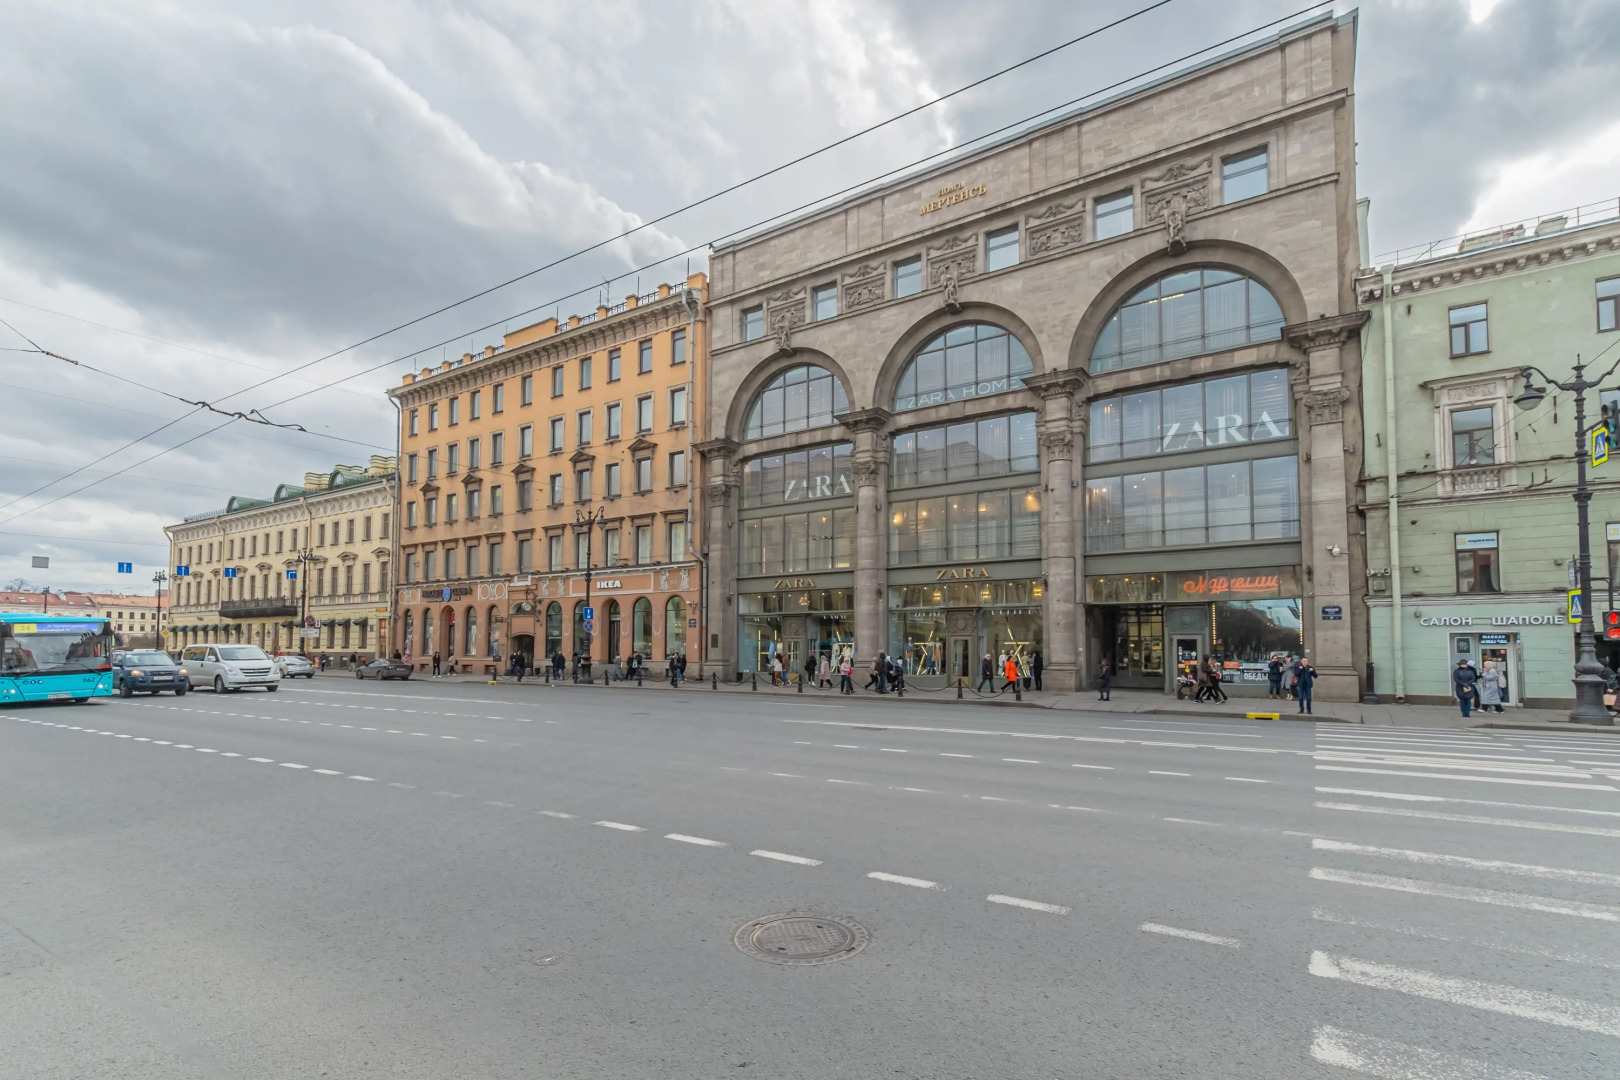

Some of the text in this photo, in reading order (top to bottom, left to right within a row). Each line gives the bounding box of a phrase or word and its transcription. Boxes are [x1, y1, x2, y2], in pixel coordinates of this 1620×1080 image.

[920, 185, 987, 216] МЕРТЕНСЪ
[907, 376, 1021, 408] ZARA HOME
[1156, 411, 1287, 452] ZARA
[785, 473, 853, 501] ZARA
[936, 567, 990, 580] ZARA
[596, 579, 622, 589] IKEA
[774, 578, 816, 589] ZARA
[1420, 615, 1565, 626] САЛОН ШАПОЛЕ
[1243, 672, 1269, 682] ОБЕДЫ
